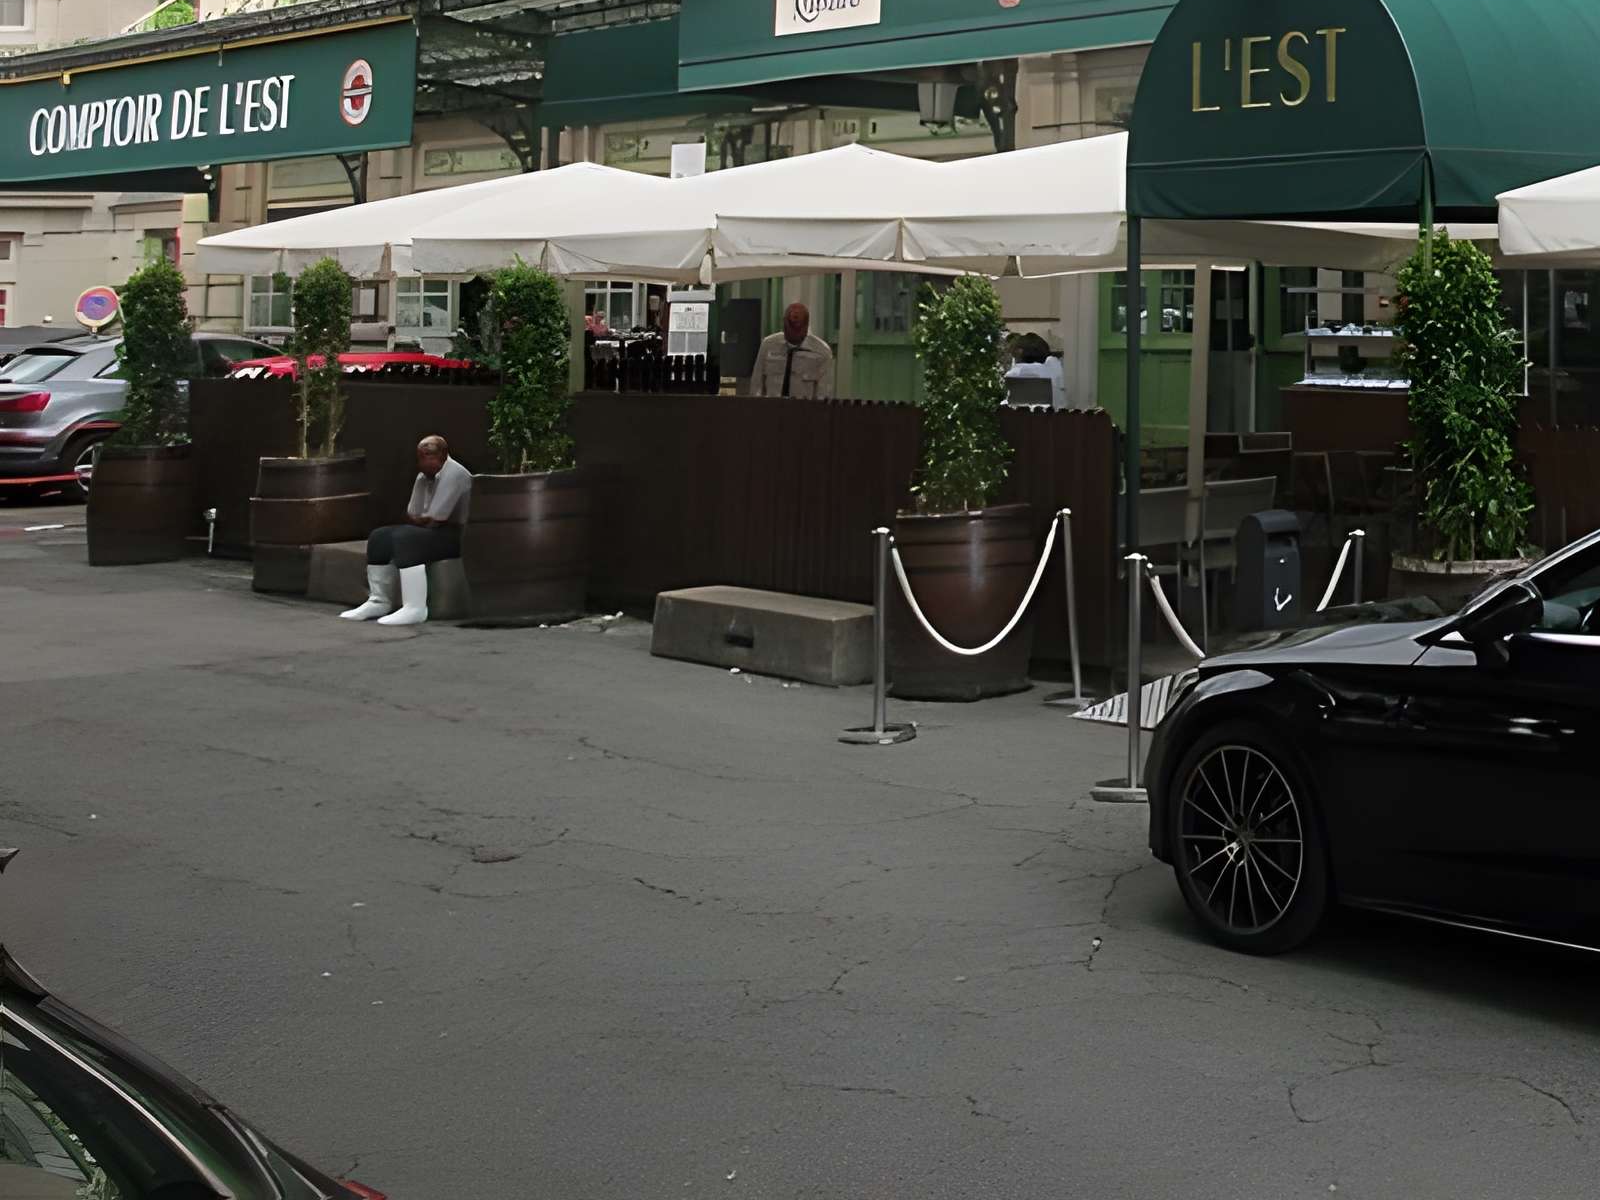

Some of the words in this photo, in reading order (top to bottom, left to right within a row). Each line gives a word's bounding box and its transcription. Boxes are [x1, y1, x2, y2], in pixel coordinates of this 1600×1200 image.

[1191, 27, 1347, 112] L'EST
[29, 93, 164, 157] COMPTOIR
[170, 85, 211, 140] DE
[219, 74, 296, 135] L'EST
